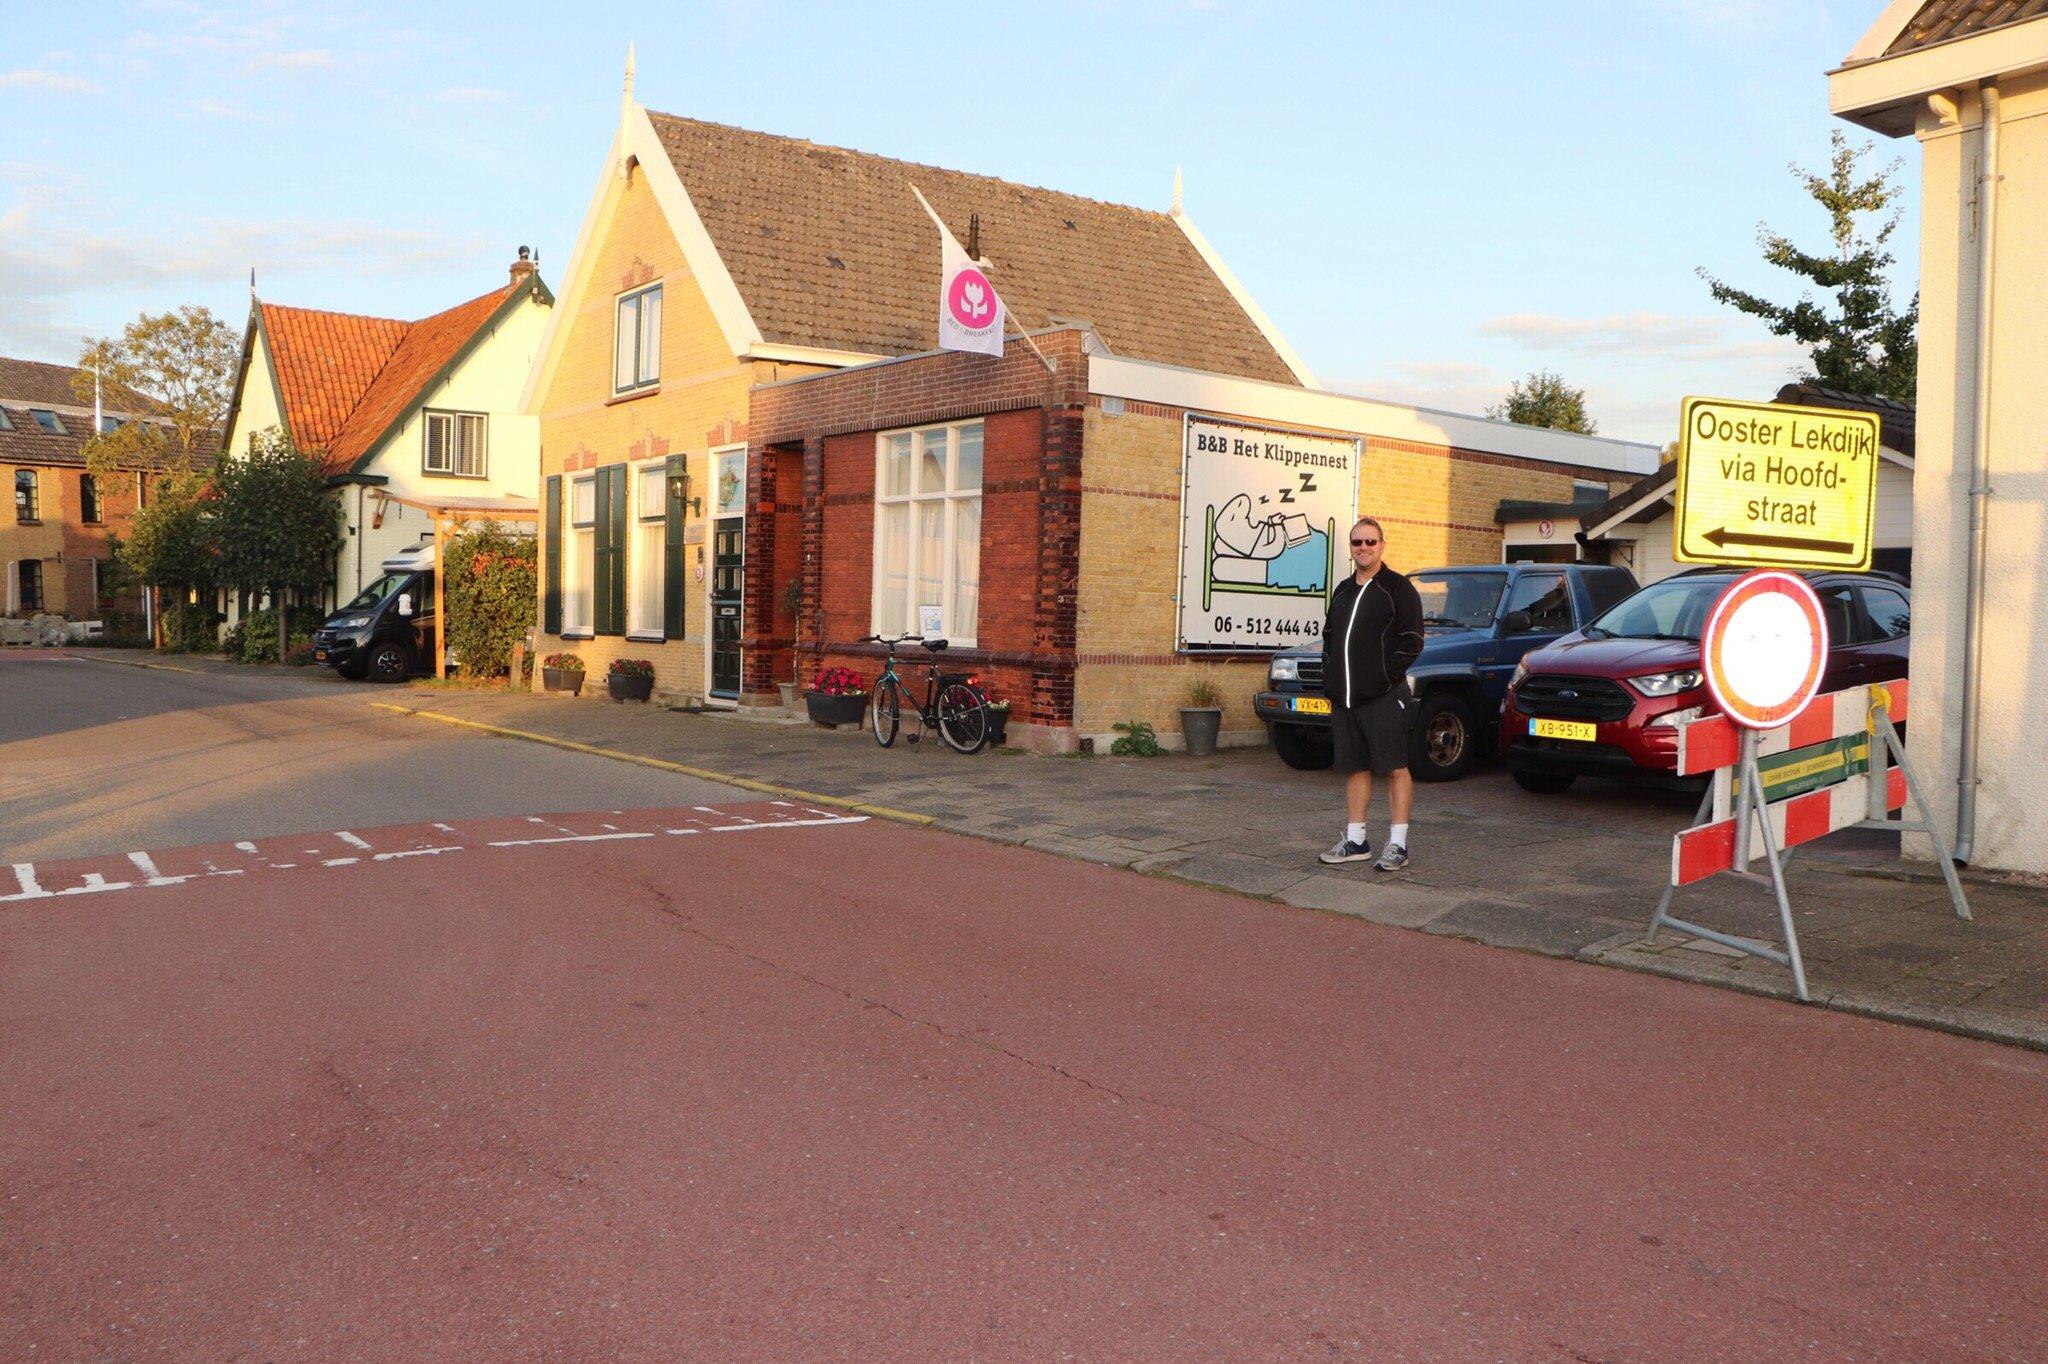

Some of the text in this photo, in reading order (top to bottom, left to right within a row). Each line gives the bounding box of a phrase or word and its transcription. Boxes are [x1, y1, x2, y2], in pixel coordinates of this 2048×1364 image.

[1197, 434, 1348, 470] B&B Het Klippennest
[1697, 411, 1873, 461] Ooster Lekdijk
[1721, 453, 1847, 489] via Hoofd-
[1747, 496, 1817, 526] straat
[1214, 616, 1233, 633] 06
[1246, 618, 1272, 634] 512
[1275, 619, 1300, 636] 444
[1303, 620, 1320, 637] 43
[1540, 721, 1591, 738] XB-951-X
